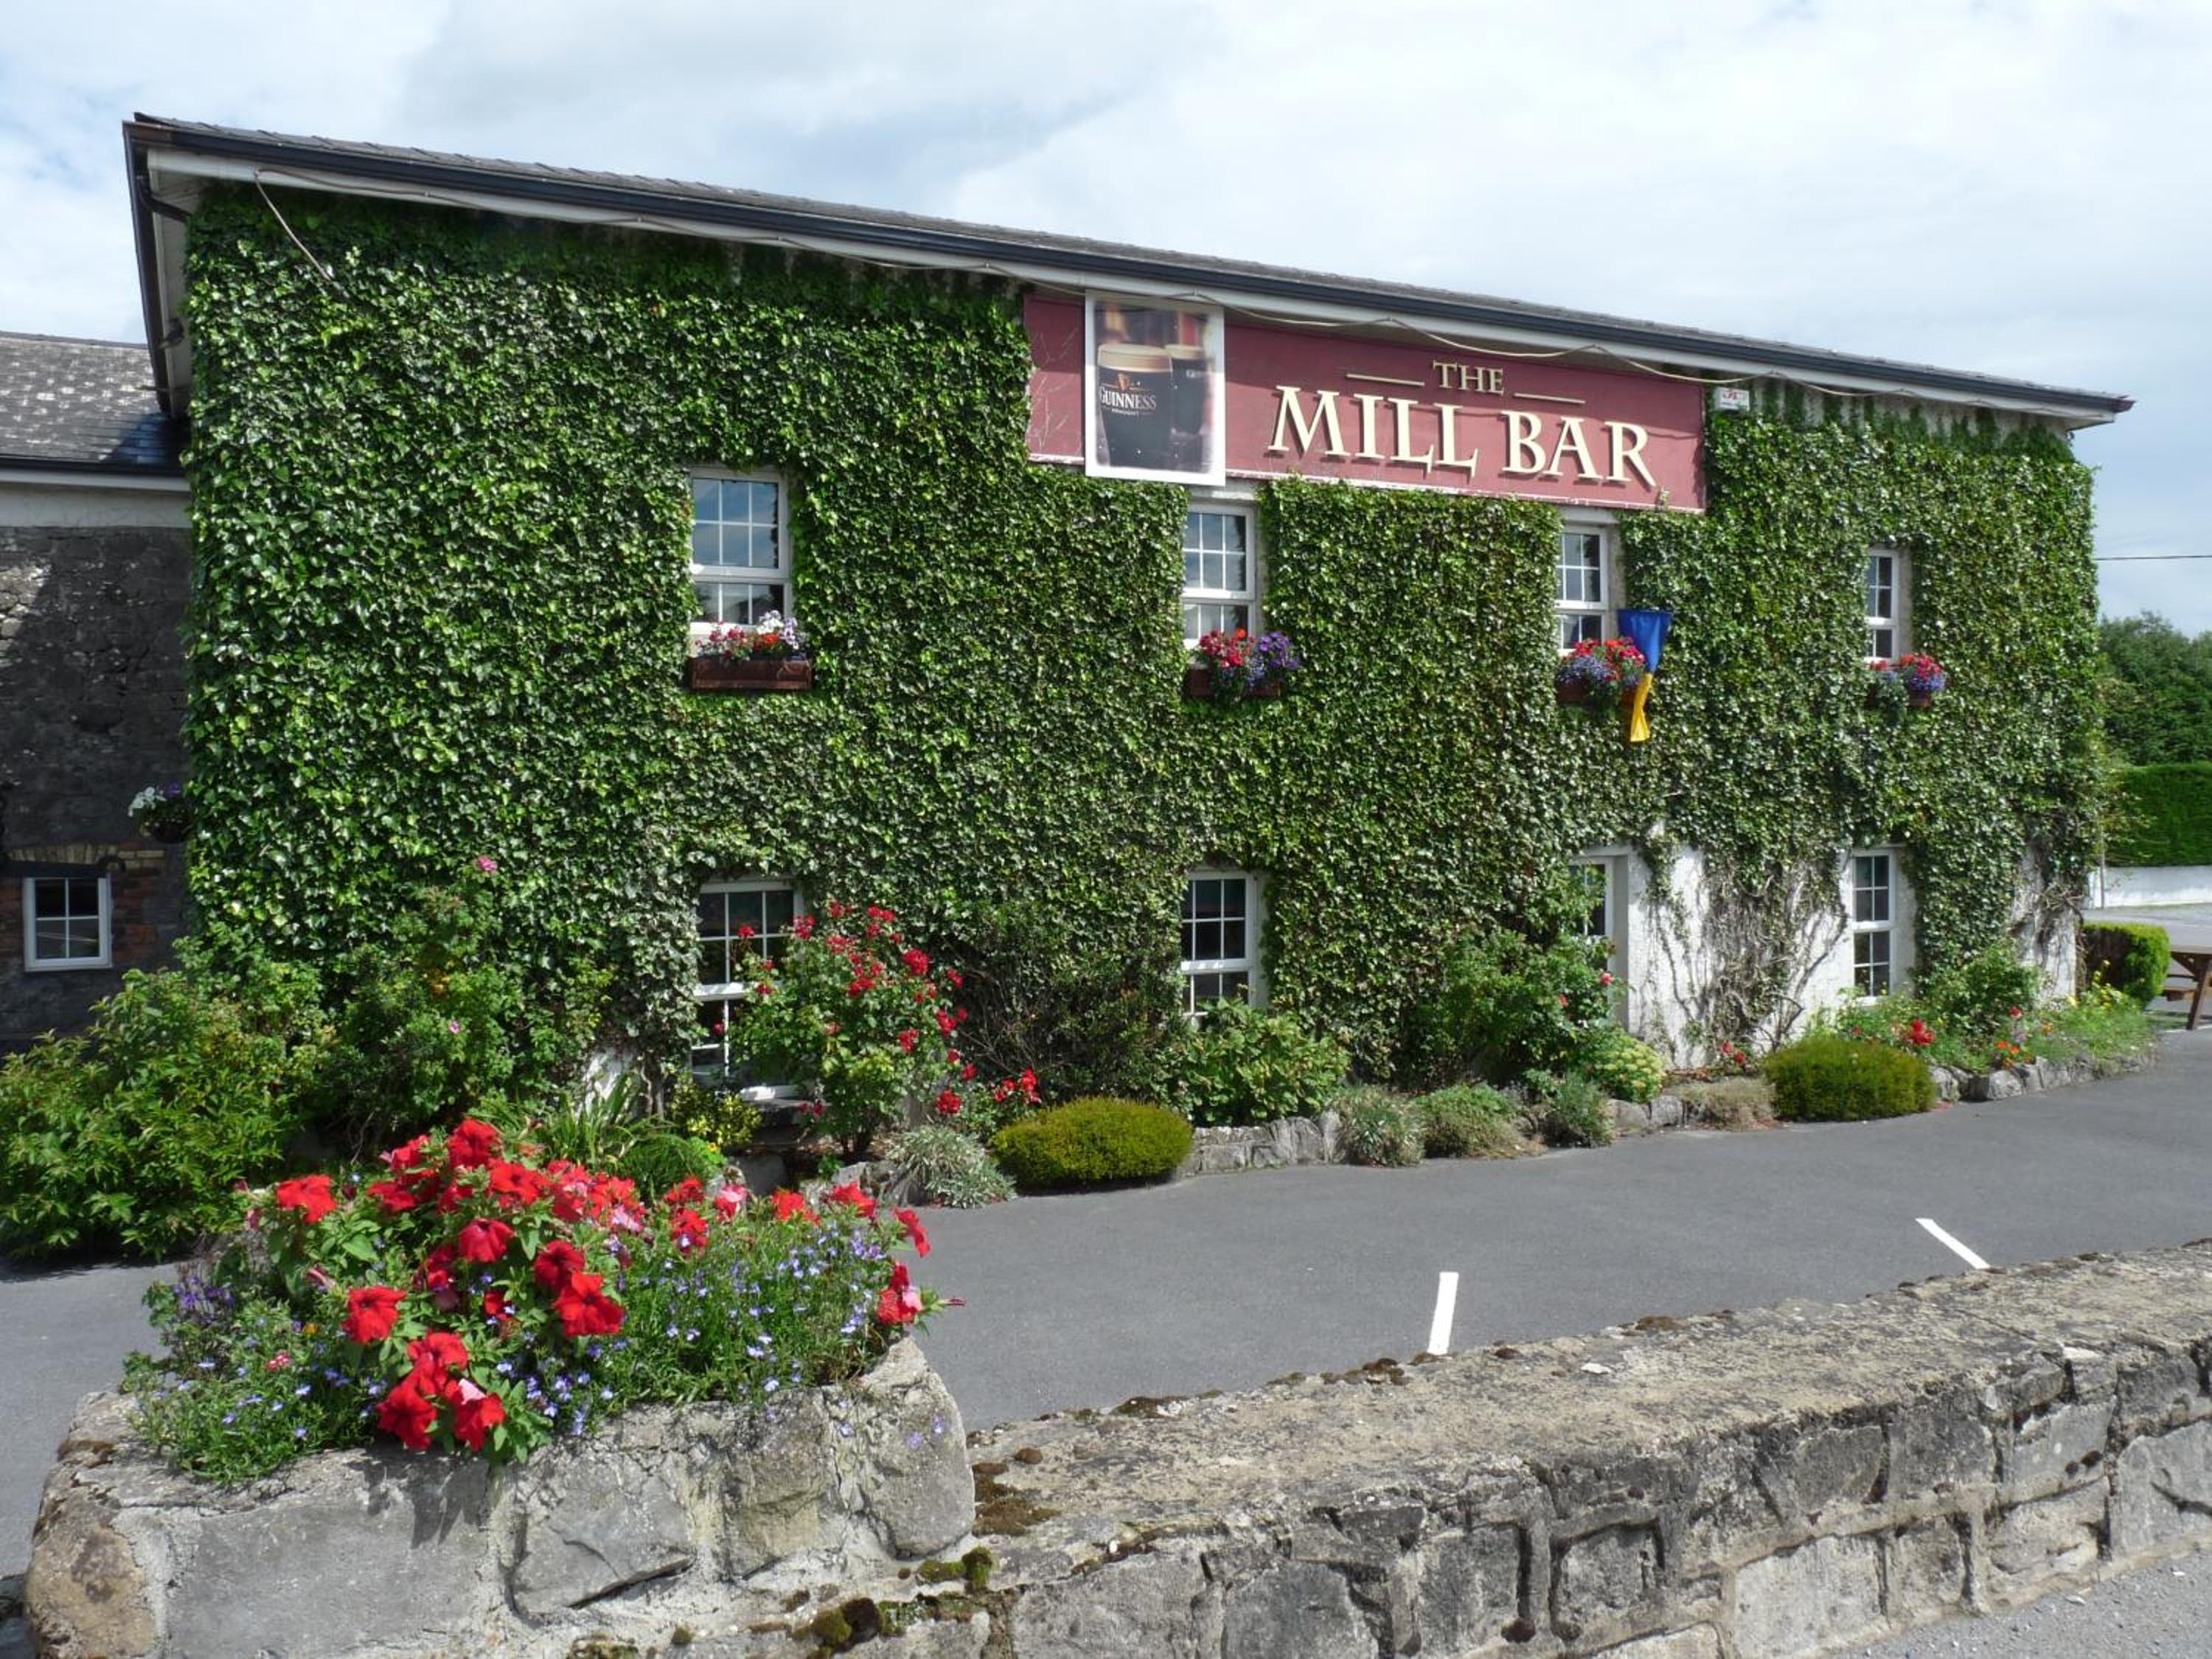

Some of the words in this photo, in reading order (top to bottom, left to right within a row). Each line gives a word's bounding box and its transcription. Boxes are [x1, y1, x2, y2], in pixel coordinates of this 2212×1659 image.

[1433, 360, 1504, 396] THE
[1099, 386, 1157, 410] GUINNESS
[1267, 385, 1478, 478] MILL
[1501, 410, 1656, 487] BAR
